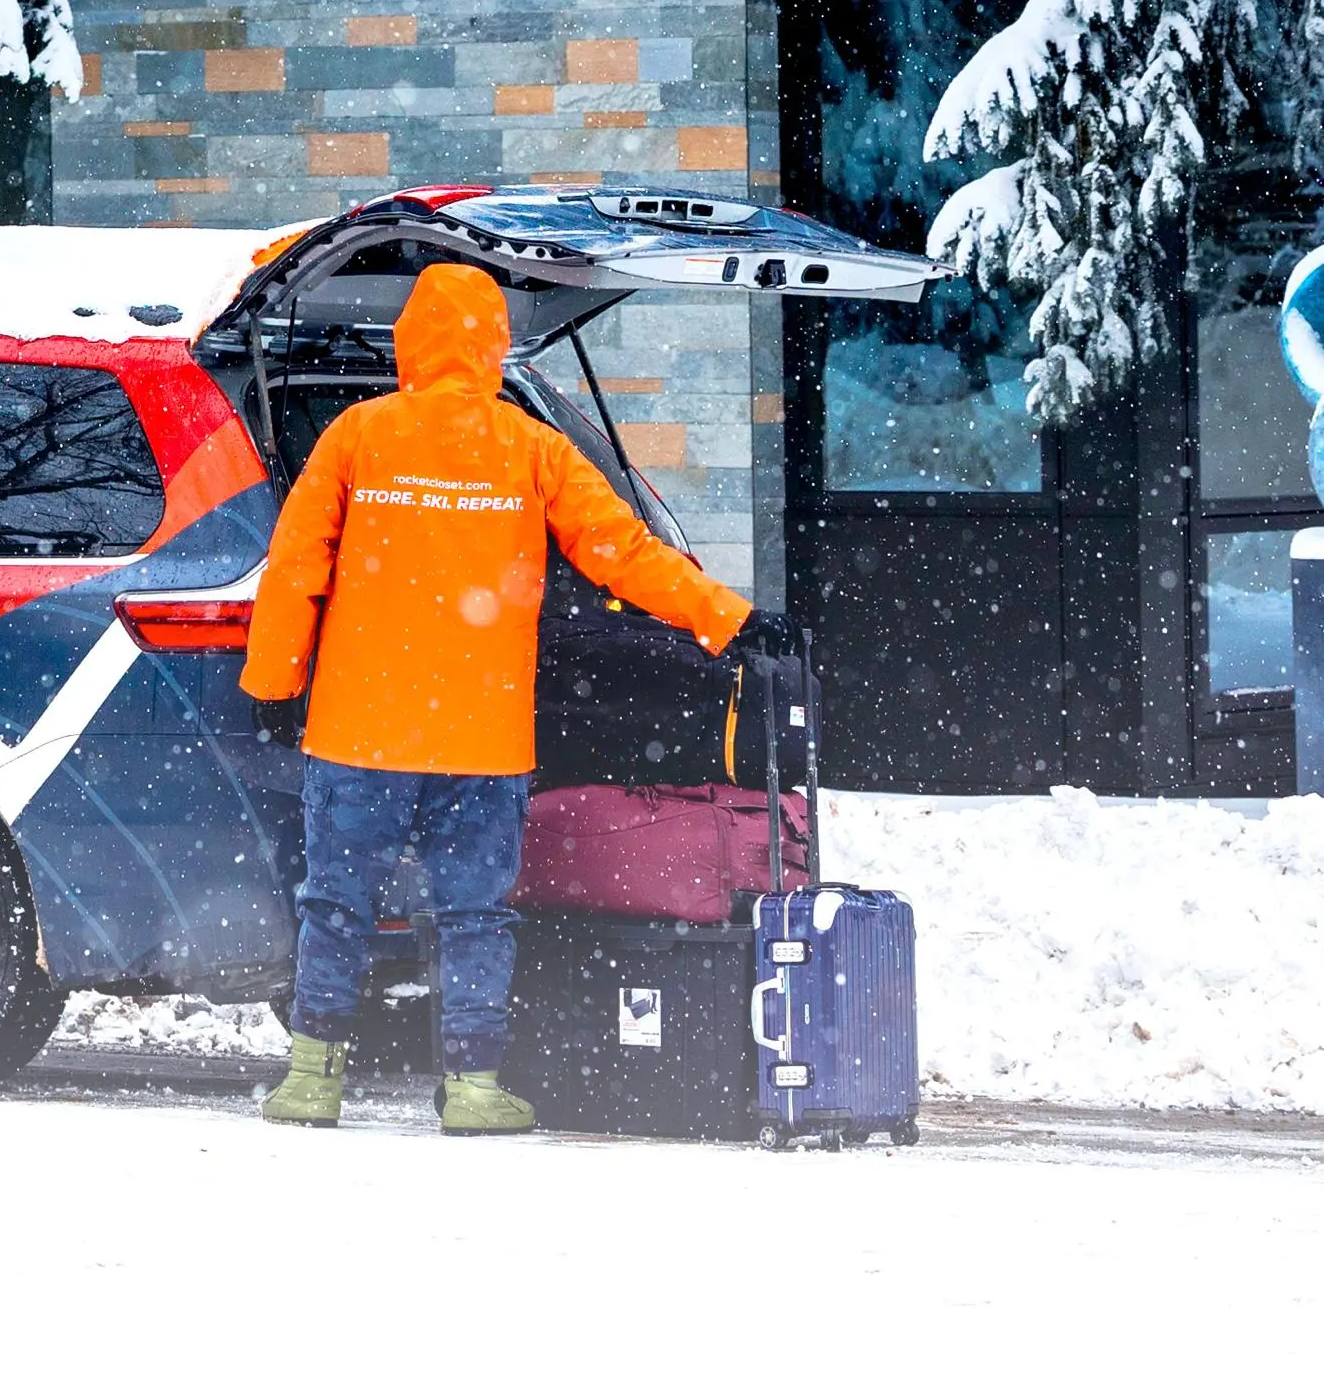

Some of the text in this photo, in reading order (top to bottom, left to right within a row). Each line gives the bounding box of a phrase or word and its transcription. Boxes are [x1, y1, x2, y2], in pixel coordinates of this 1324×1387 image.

[393, 475, 492, 490] rocketcloset.com
[354, 489, 524, 512] STORE. SKI. REPEAT.
